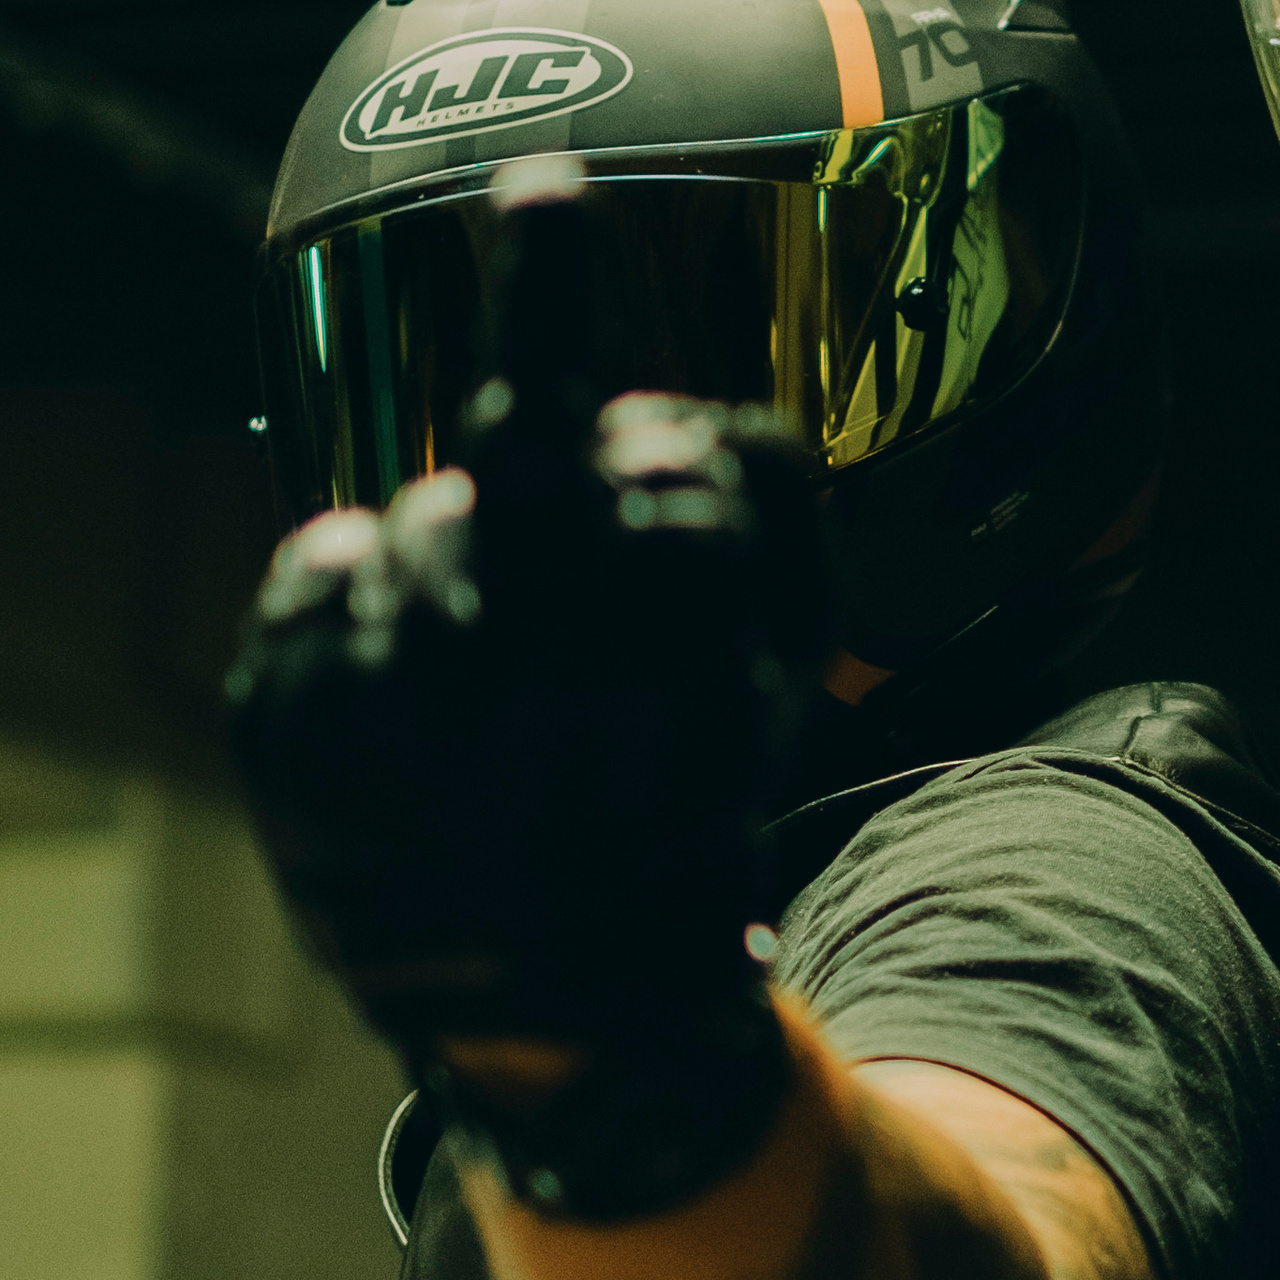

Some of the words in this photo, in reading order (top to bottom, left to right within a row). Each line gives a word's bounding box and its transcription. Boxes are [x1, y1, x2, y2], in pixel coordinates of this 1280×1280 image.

[897, 22, 985, 81] 70
[369, 49, 586, 133] HJC
[416, 101, 516, 127] HELMETS
